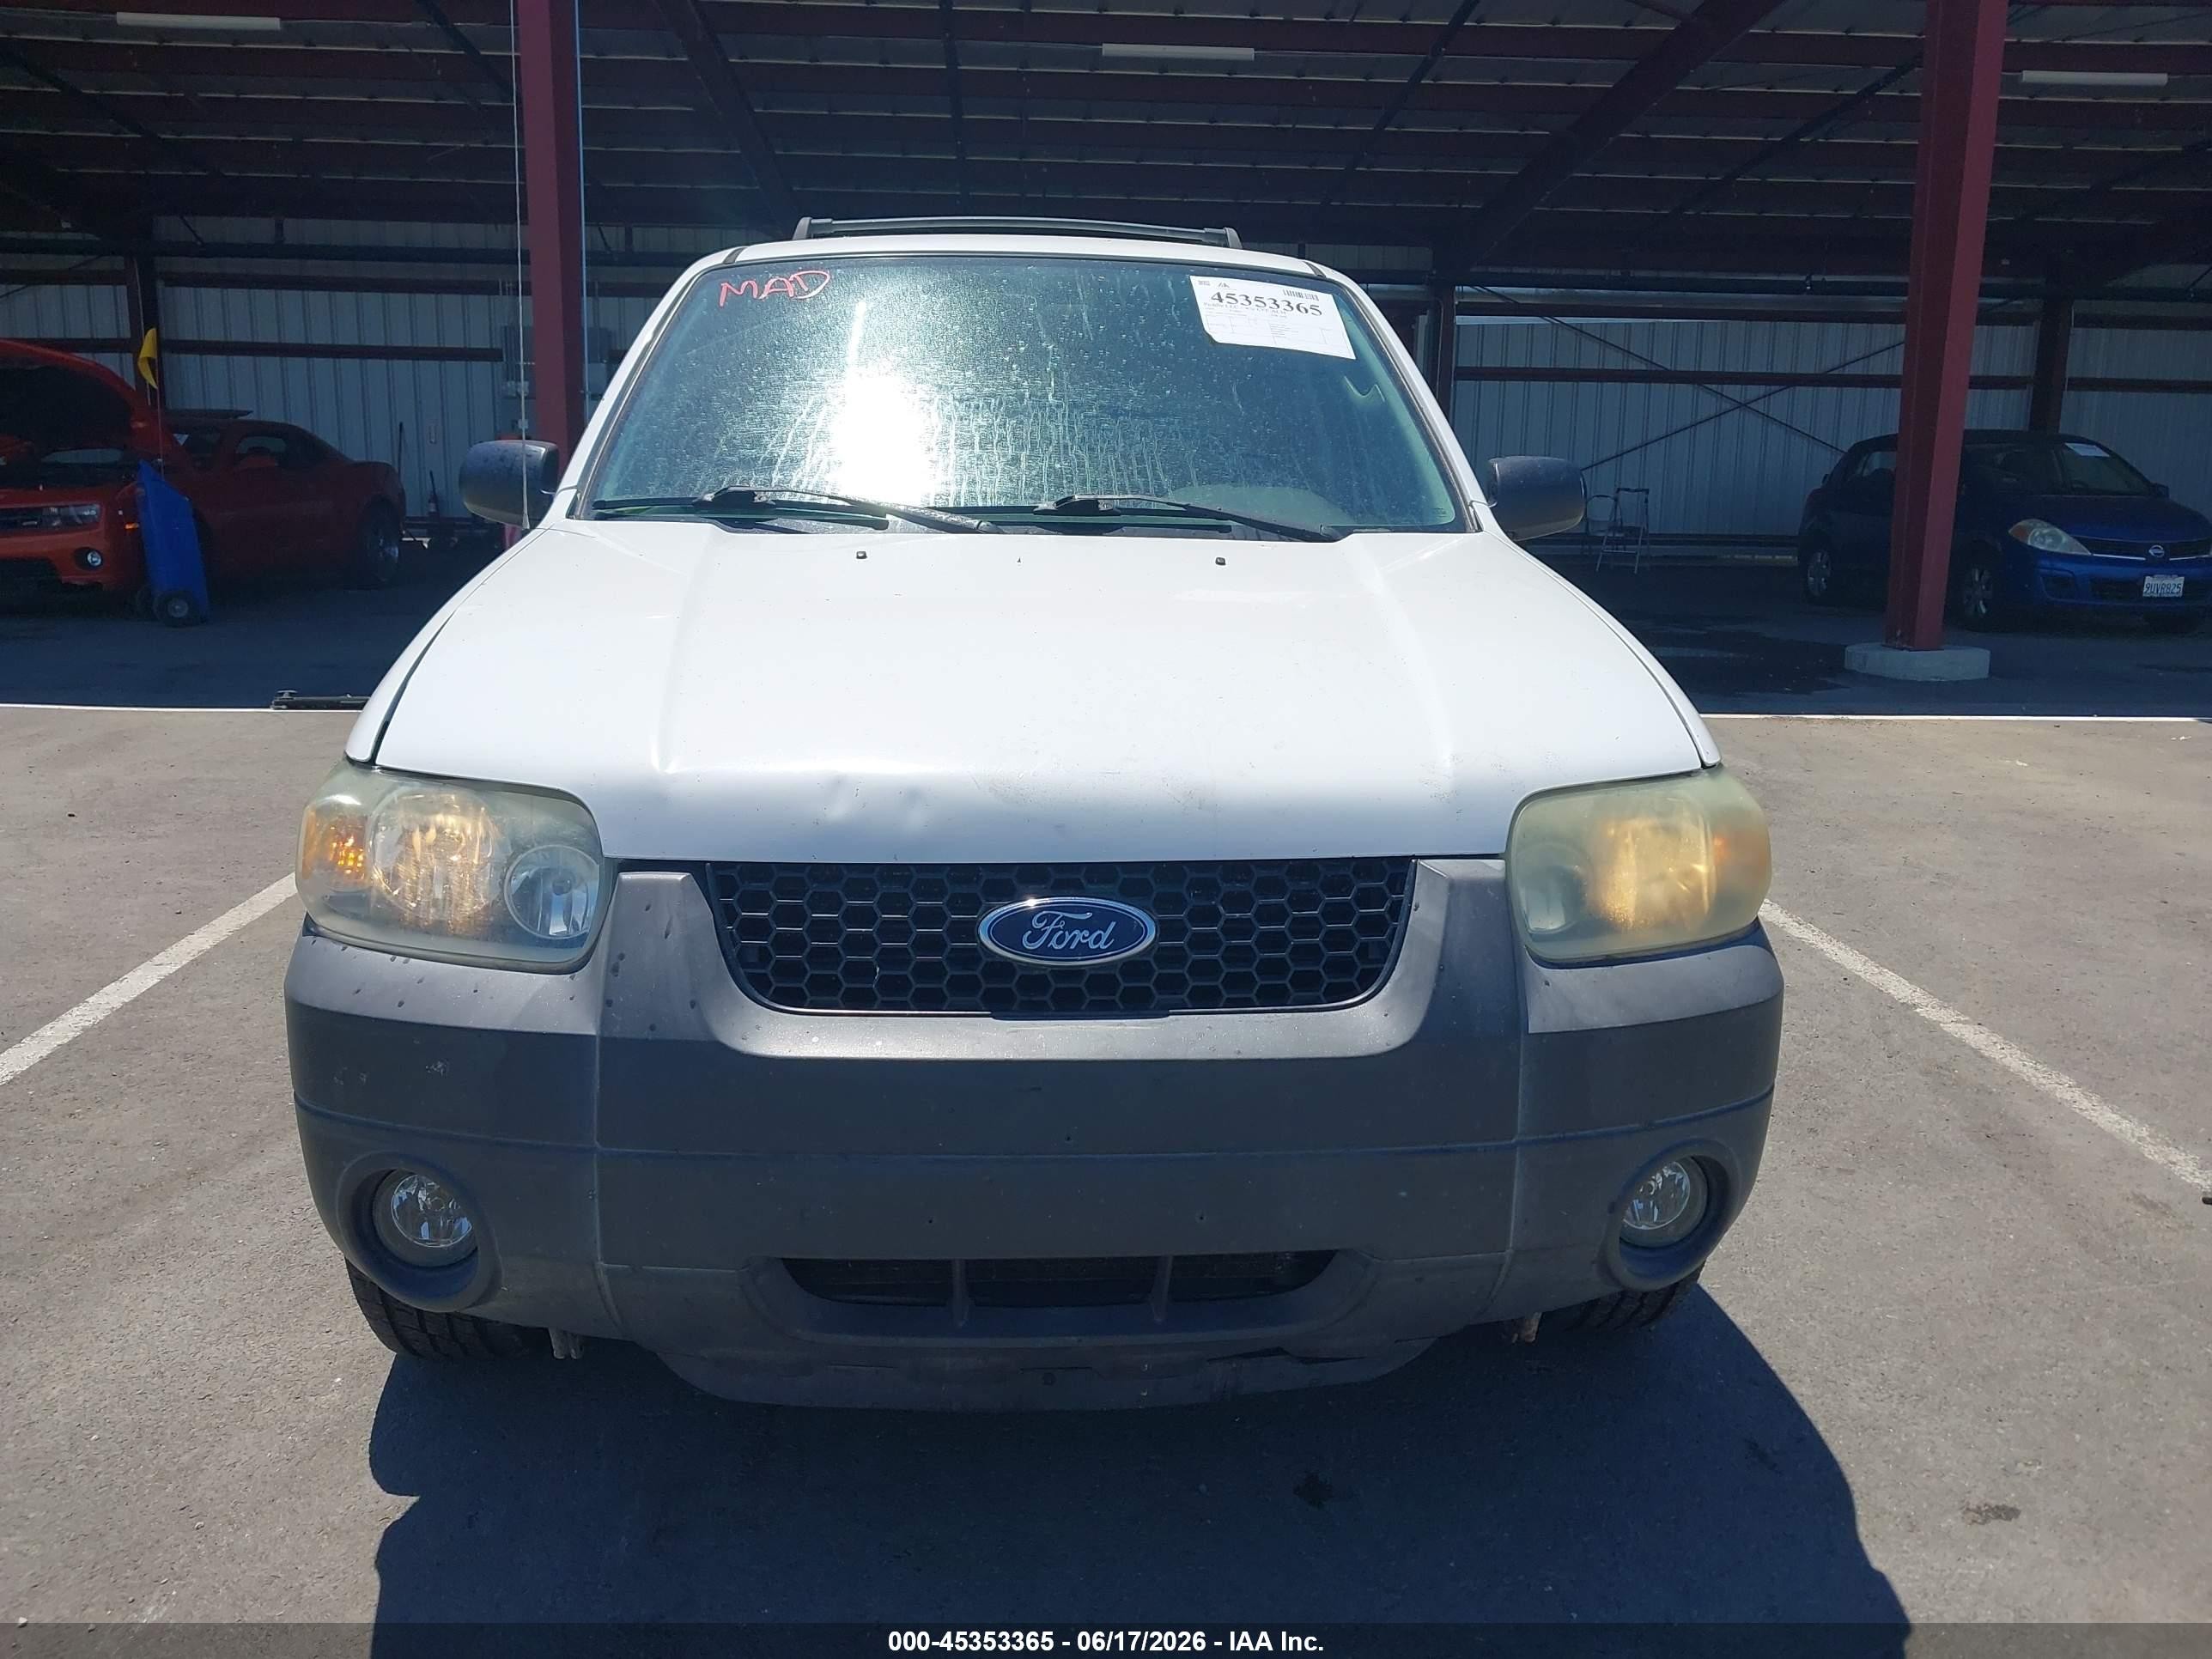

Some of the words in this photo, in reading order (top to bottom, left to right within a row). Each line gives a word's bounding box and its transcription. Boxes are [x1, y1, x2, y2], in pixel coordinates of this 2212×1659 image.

[720, 270, 830, 307] MAD
[1211, 291, 1322, 317] 45353365
[1022, 910, 1116, 950] Ford
